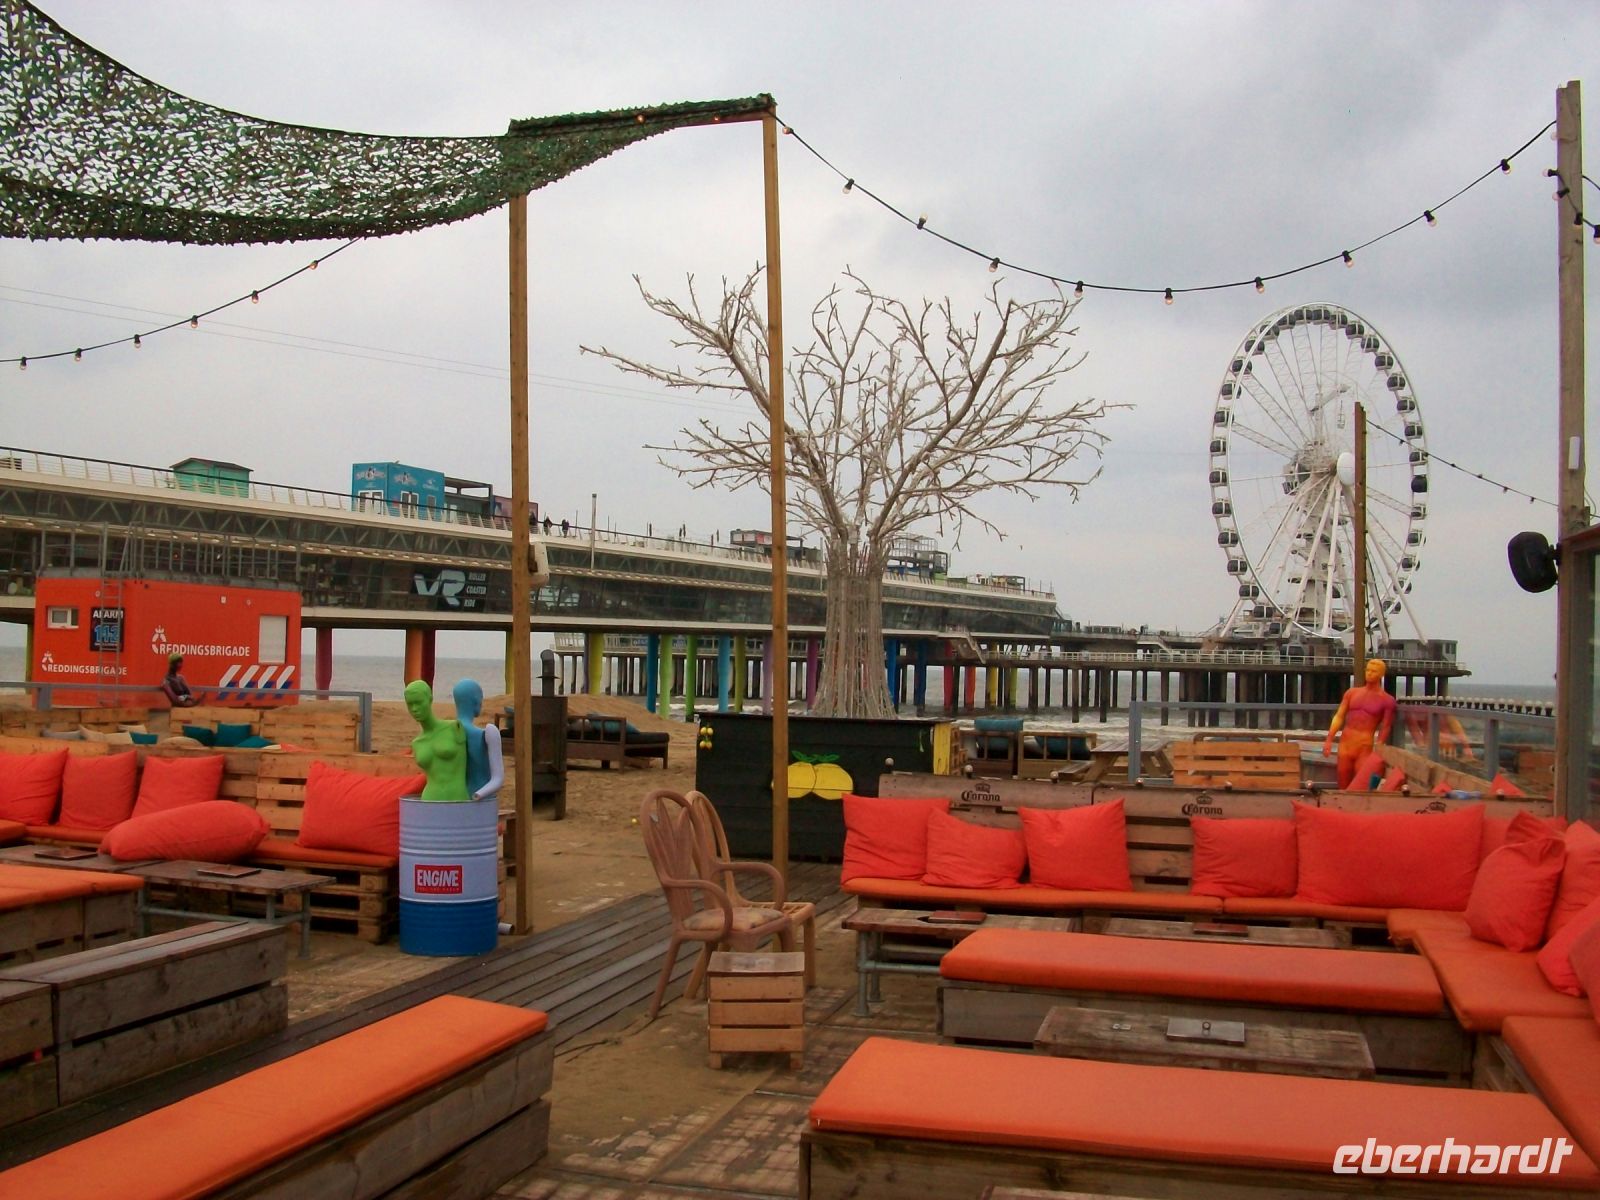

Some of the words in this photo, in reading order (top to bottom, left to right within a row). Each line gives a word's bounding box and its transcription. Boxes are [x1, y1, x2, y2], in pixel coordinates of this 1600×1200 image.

[414, 569, 466, 606] VR
[466, 585, 487, 594] COASTER
[160, 643, 250, 656] REDDINGSBRIGADE
[961, 790, 1000, 801] Corona
[1181, 803, 1223, 816] Corona
[417, 869, 459, 887] ENGINE
